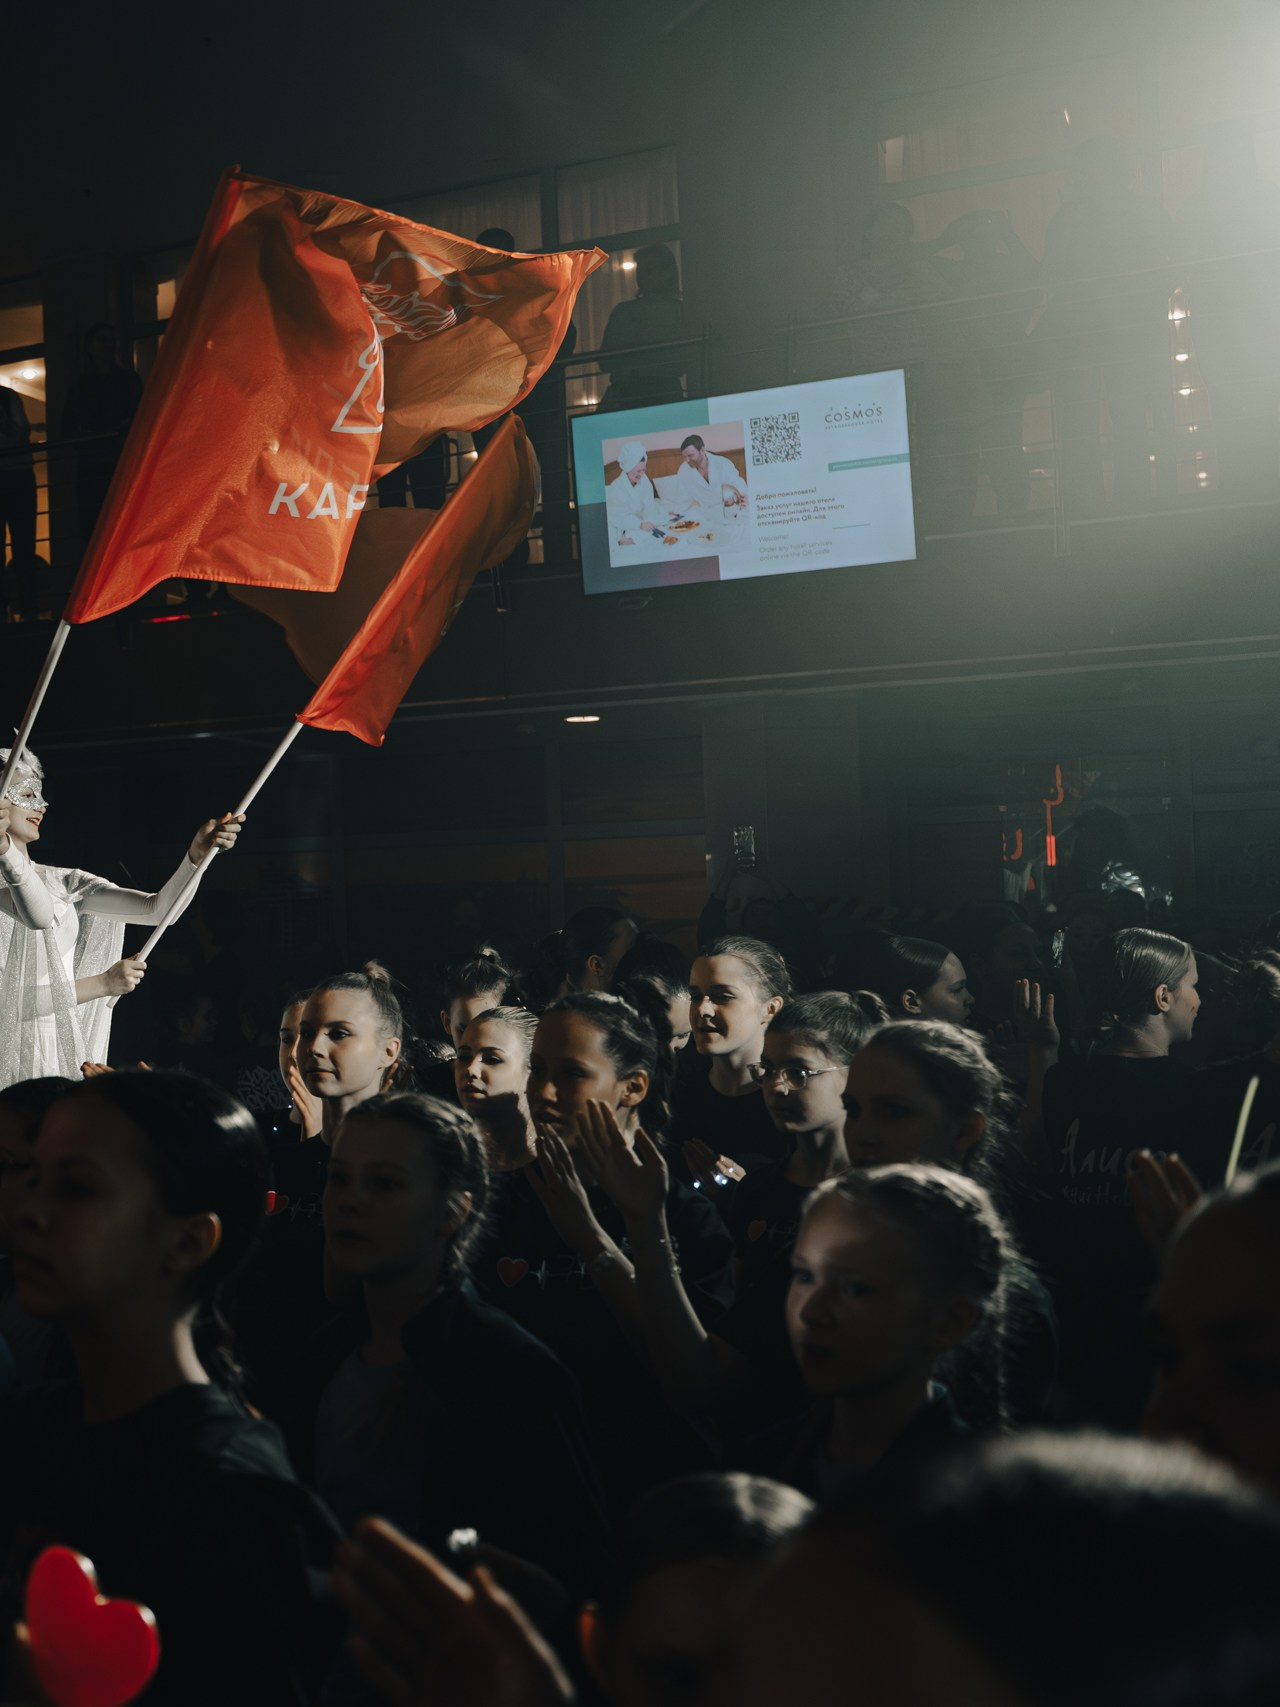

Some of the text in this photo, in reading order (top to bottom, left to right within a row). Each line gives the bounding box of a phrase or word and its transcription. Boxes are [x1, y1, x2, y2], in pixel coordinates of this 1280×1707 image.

[824, 406, 883, 424] COSMOS
[755, 487, 817, 501] Добро пожаловать!
[756, 504, 774, 512] Заказ
[775, 502, 792, 510] услуг
[813, 505, 826, 513] Для
